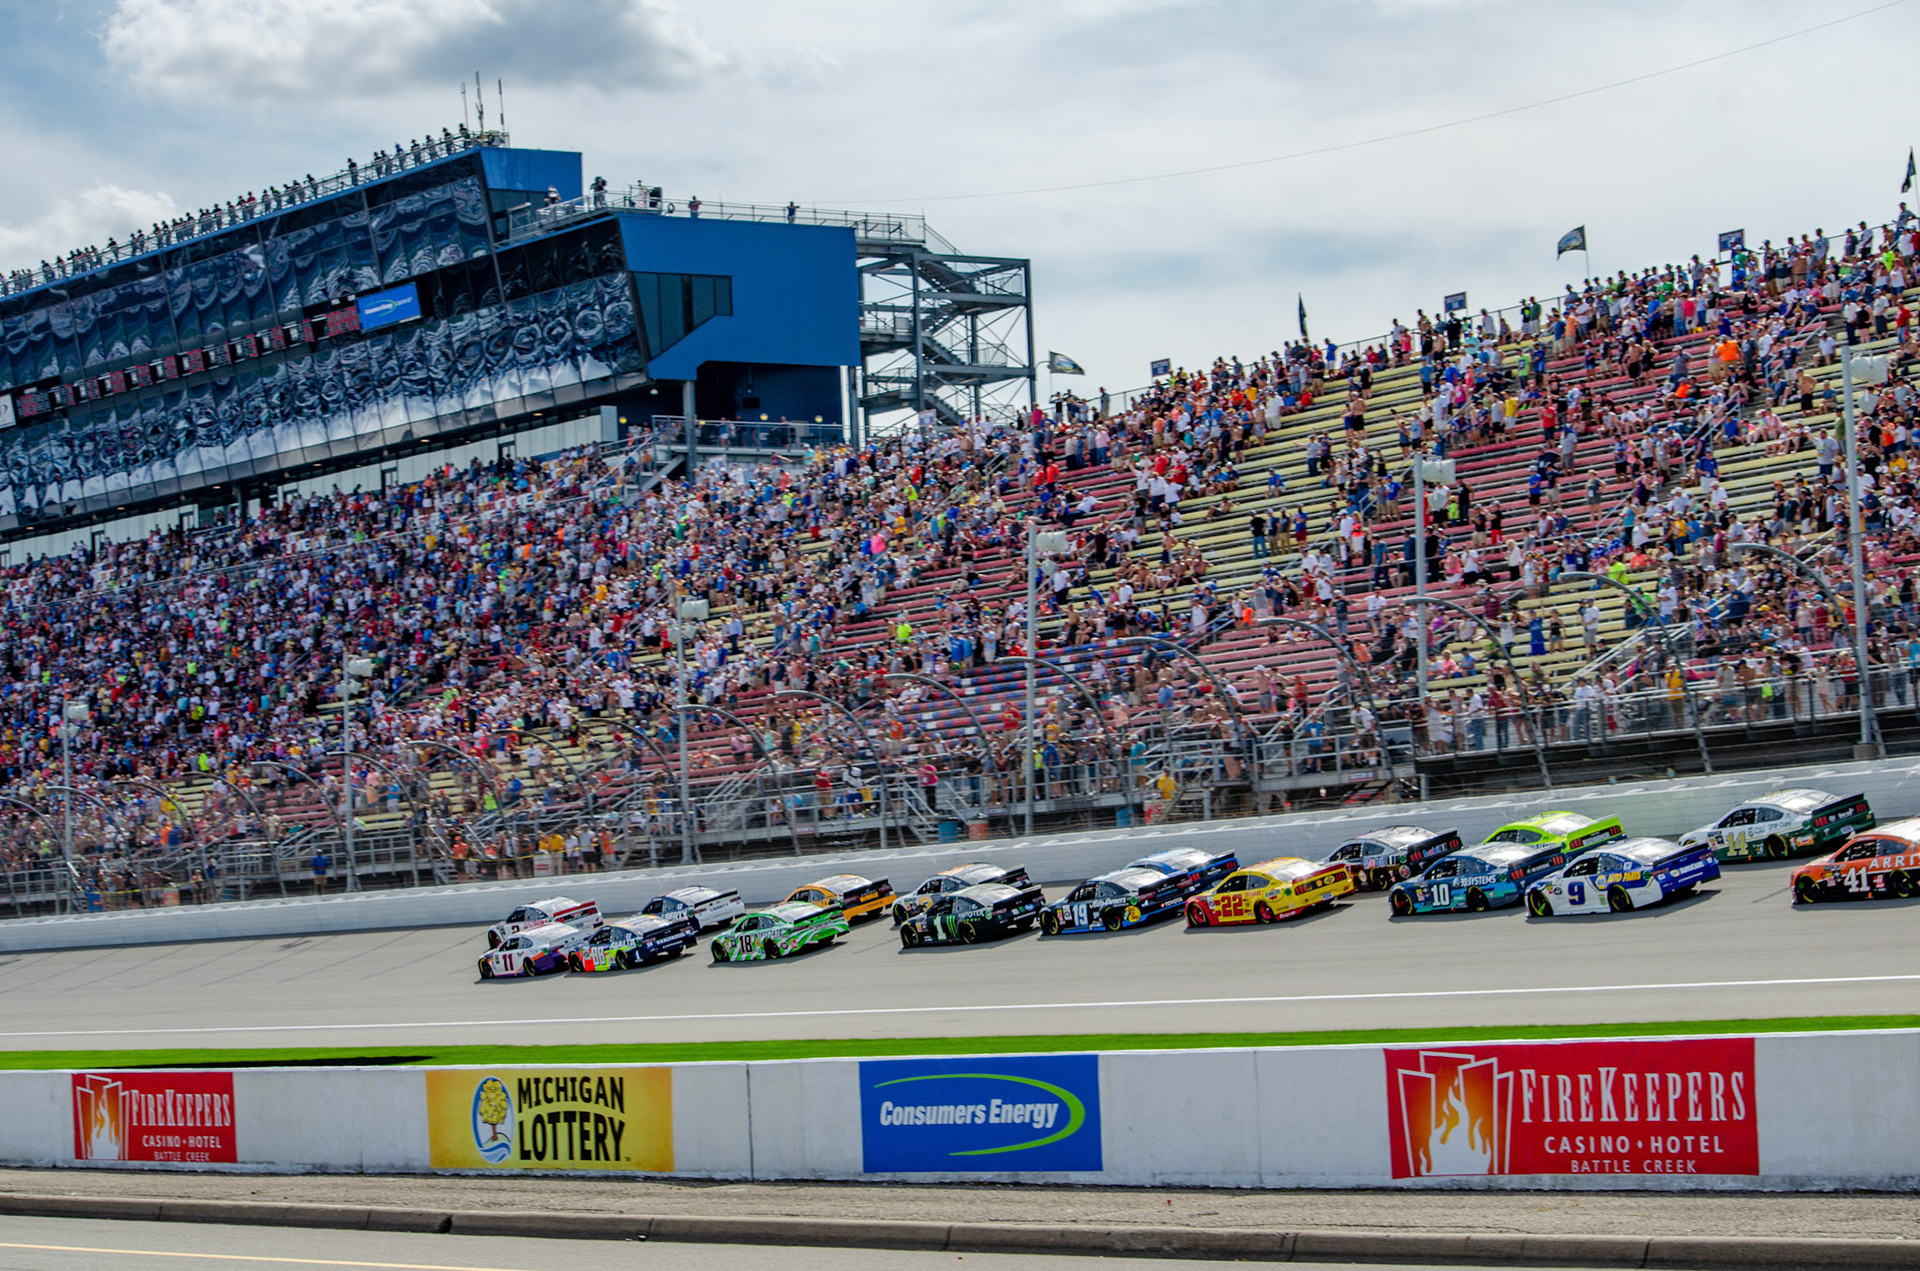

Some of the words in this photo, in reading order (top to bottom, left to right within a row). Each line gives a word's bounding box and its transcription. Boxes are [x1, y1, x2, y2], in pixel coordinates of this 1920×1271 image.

[1727, 831, 1749, 856] 14
[1869, 855, 1920, 870] ARRI
[1467, 875, 1497, 886] SYSTEMS
[1608, 873, 1622, 883] AUTO
[1622, 871, 1641, 882] PARTS
[1843, 866, 1870, 893] 41
[1164, 897, 1184, 907] TOYOTA
[1431, 884, 1450, 907] 10
[1568, 881, 1586, 906] 9
[1072, 903, 1089, 927] 19
[1220, 894, 1244, 917] 22
[934, 916, 947, 940] 1
[739, 934, 753, 953] 18
[502, 953, 515, 972] 11
[591, 946, 607, 966] 88
[517, 1076, 625, 1114] MICHIGAN
[880, 1101, 986, 1126] Consumers
[988, 1099, 1059, 1129] Energy
[142, 1135, 181, 1148] CASINO
[188, 1136, 222, 1148] HOTEL
[519, 1110, 626, 1161] LOTTERY
[1544, 1136, 1630, 1154] CASINO
[1651, 1135, 1724, 1153] HOTEL
[154, 1151, 182, 1161] BATTLE
[186, 1152, 210, 1162] CREEK
[1571, 1159, 1631, 1173] BATTLE
[1643, 1159, 1697, 1173] CREEK
